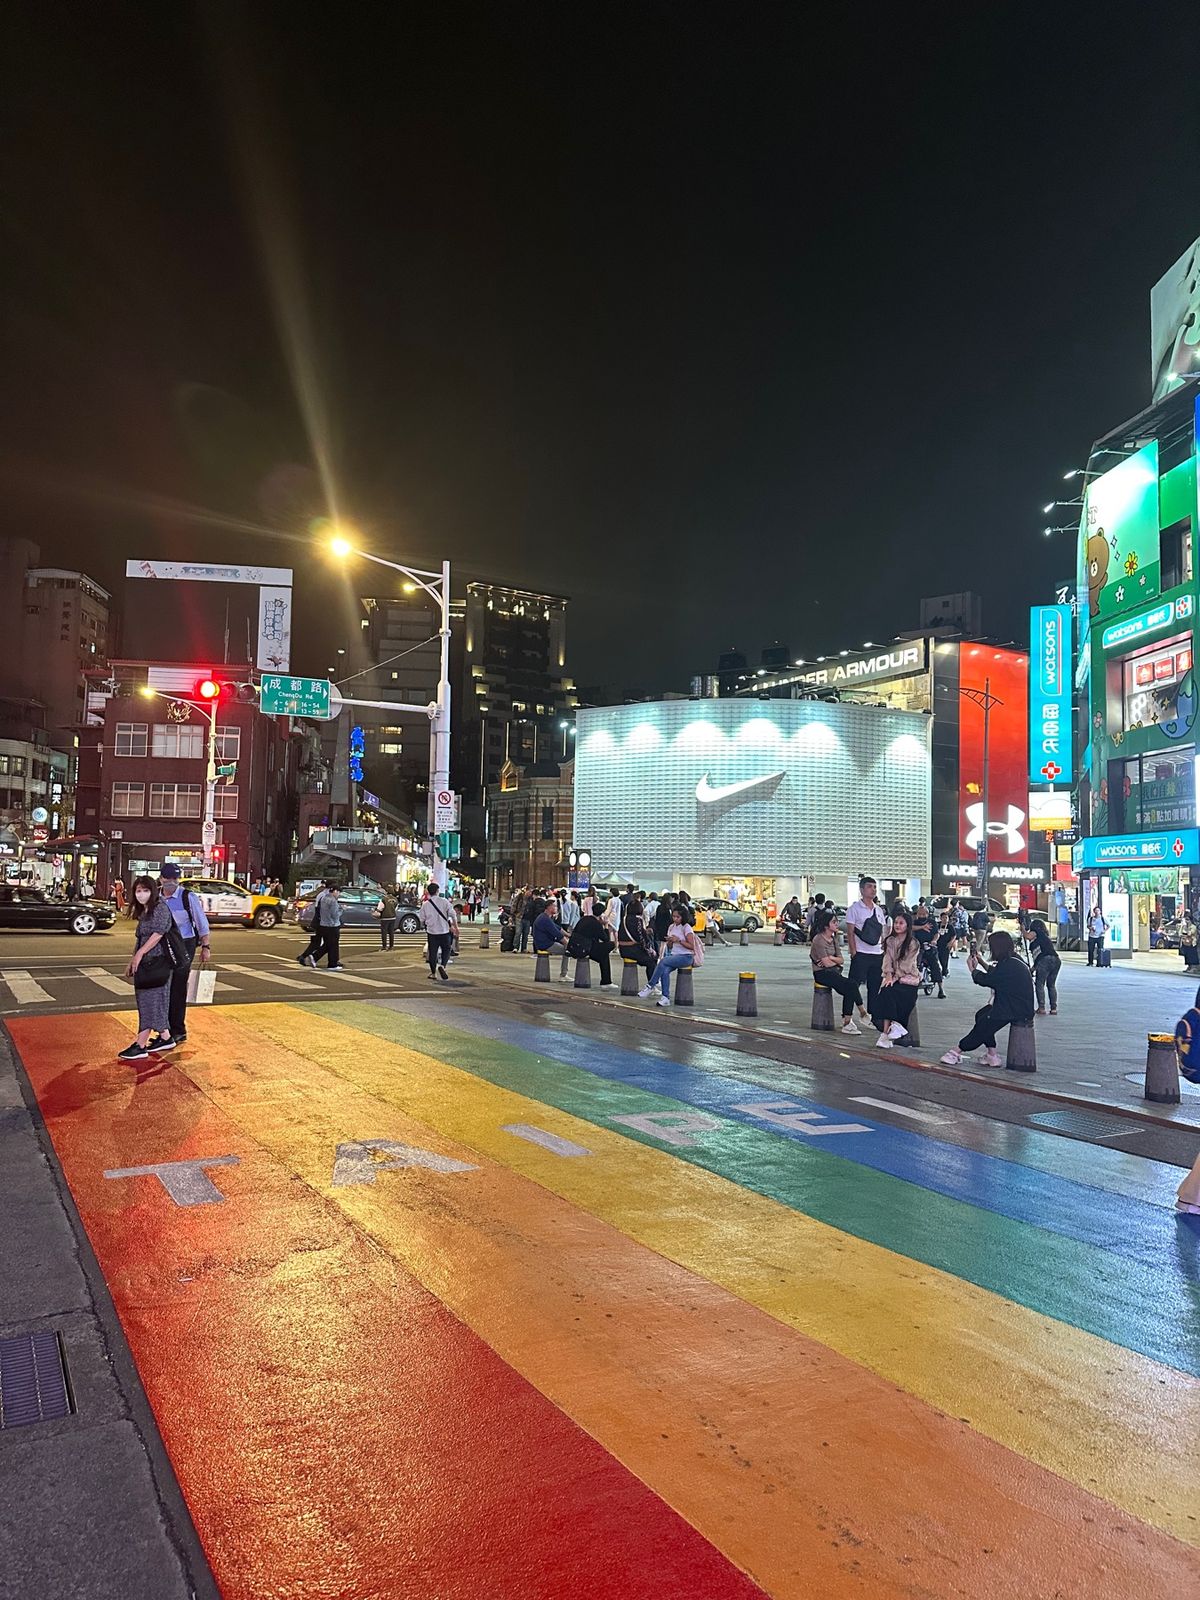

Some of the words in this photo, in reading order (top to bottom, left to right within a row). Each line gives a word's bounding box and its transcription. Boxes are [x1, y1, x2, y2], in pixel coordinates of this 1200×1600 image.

[1107, 620, 1143, 641] watsons
[1045, 620, 1056, 685] watsons
[833, 647, 919, 682] ARMOUR
[269, 678, 322, 693] 成都路
[1042, 703, 1060, 754] 屈臣氏
[1100, 844, 1138, 857] watsons
[942, 864, 979, 877] UNDE
[989, 866, 1045, 880] ARMOUR
